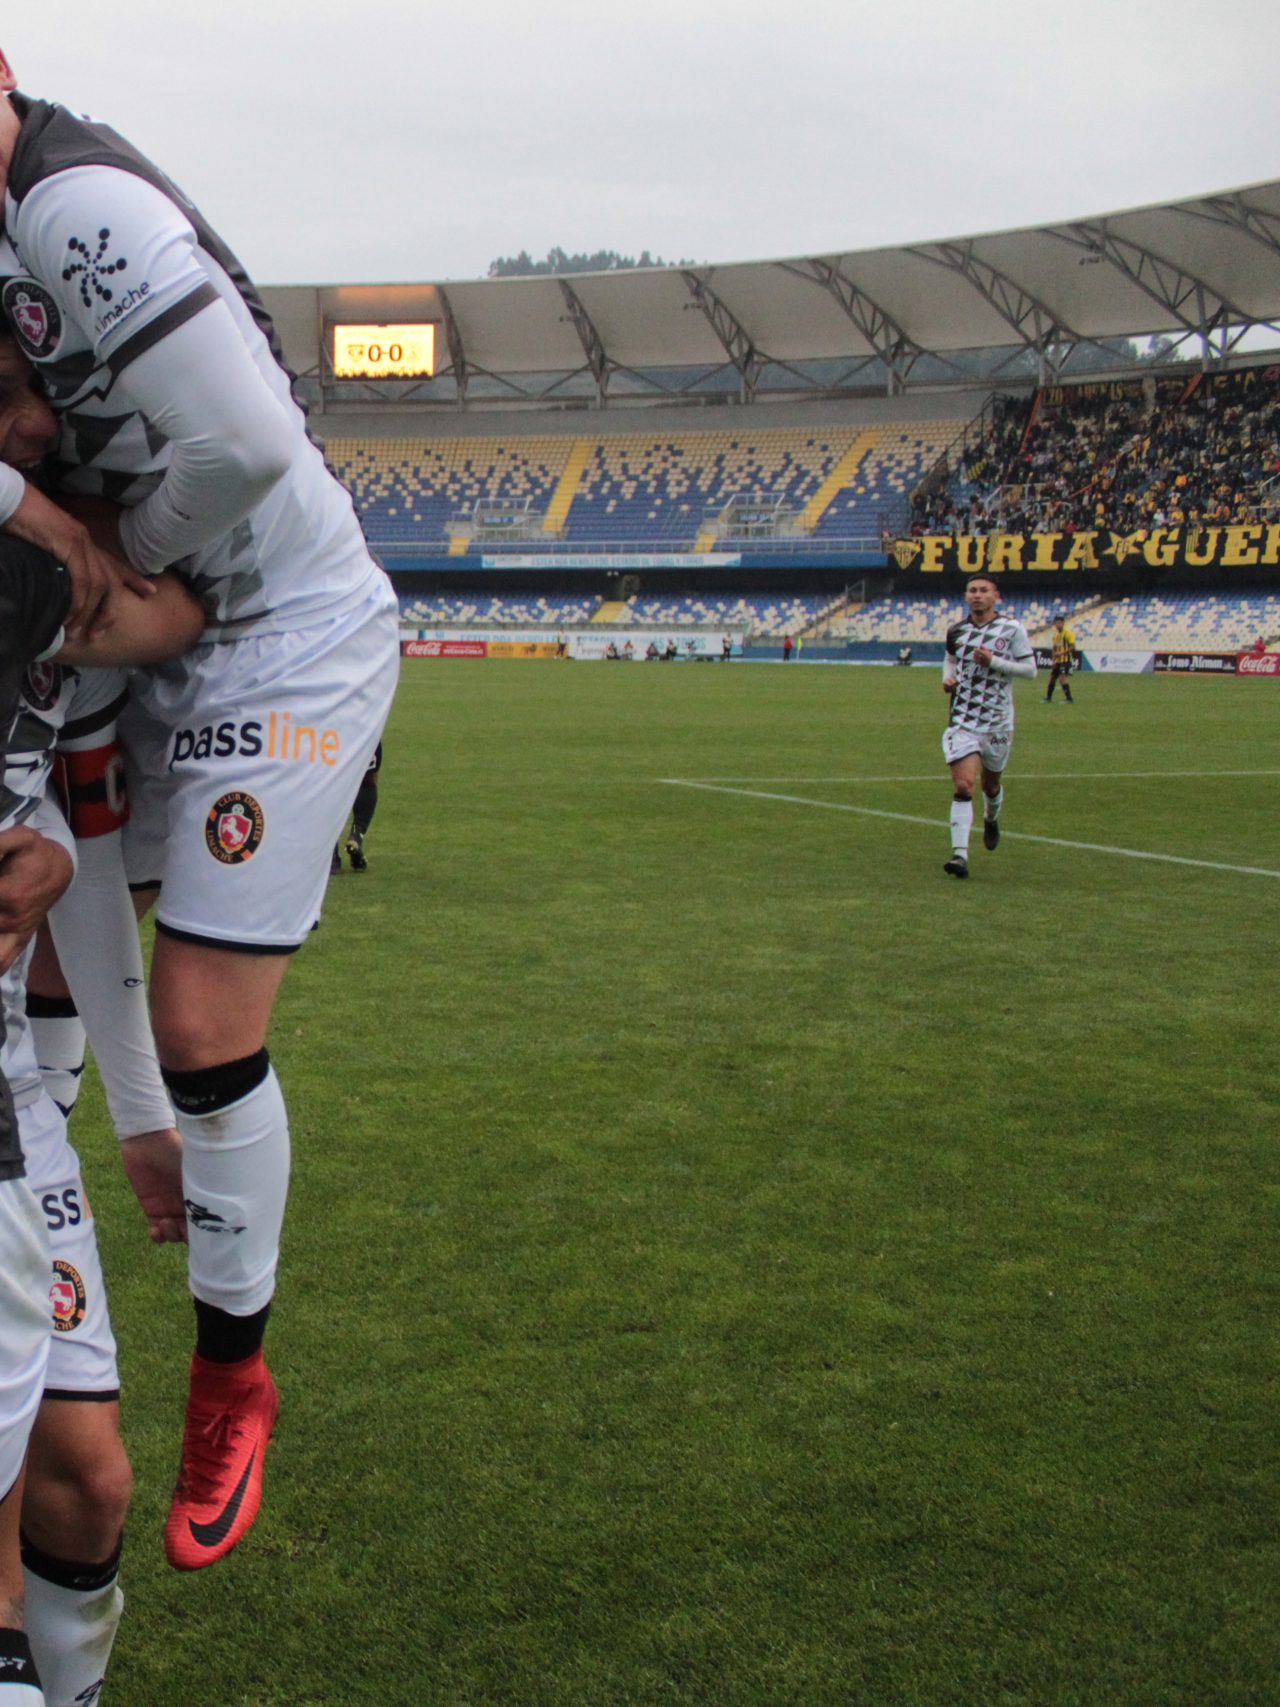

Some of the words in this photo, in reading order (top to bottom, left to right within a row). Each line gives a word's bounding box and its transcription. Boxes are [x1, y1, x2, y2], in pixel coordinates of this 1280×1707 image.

[368, 344, 403, 362] 0-0
[920, 531, 1100, 573] FURIA
[168, 710, 341, 773] passline
[218, 793, 241, 808] CLUB
[243, 795, 263, 842] DEPORTES
[206, 829, 234, 863] LIMACHE
[56, 1262, 85, 1298] DEPORTES
